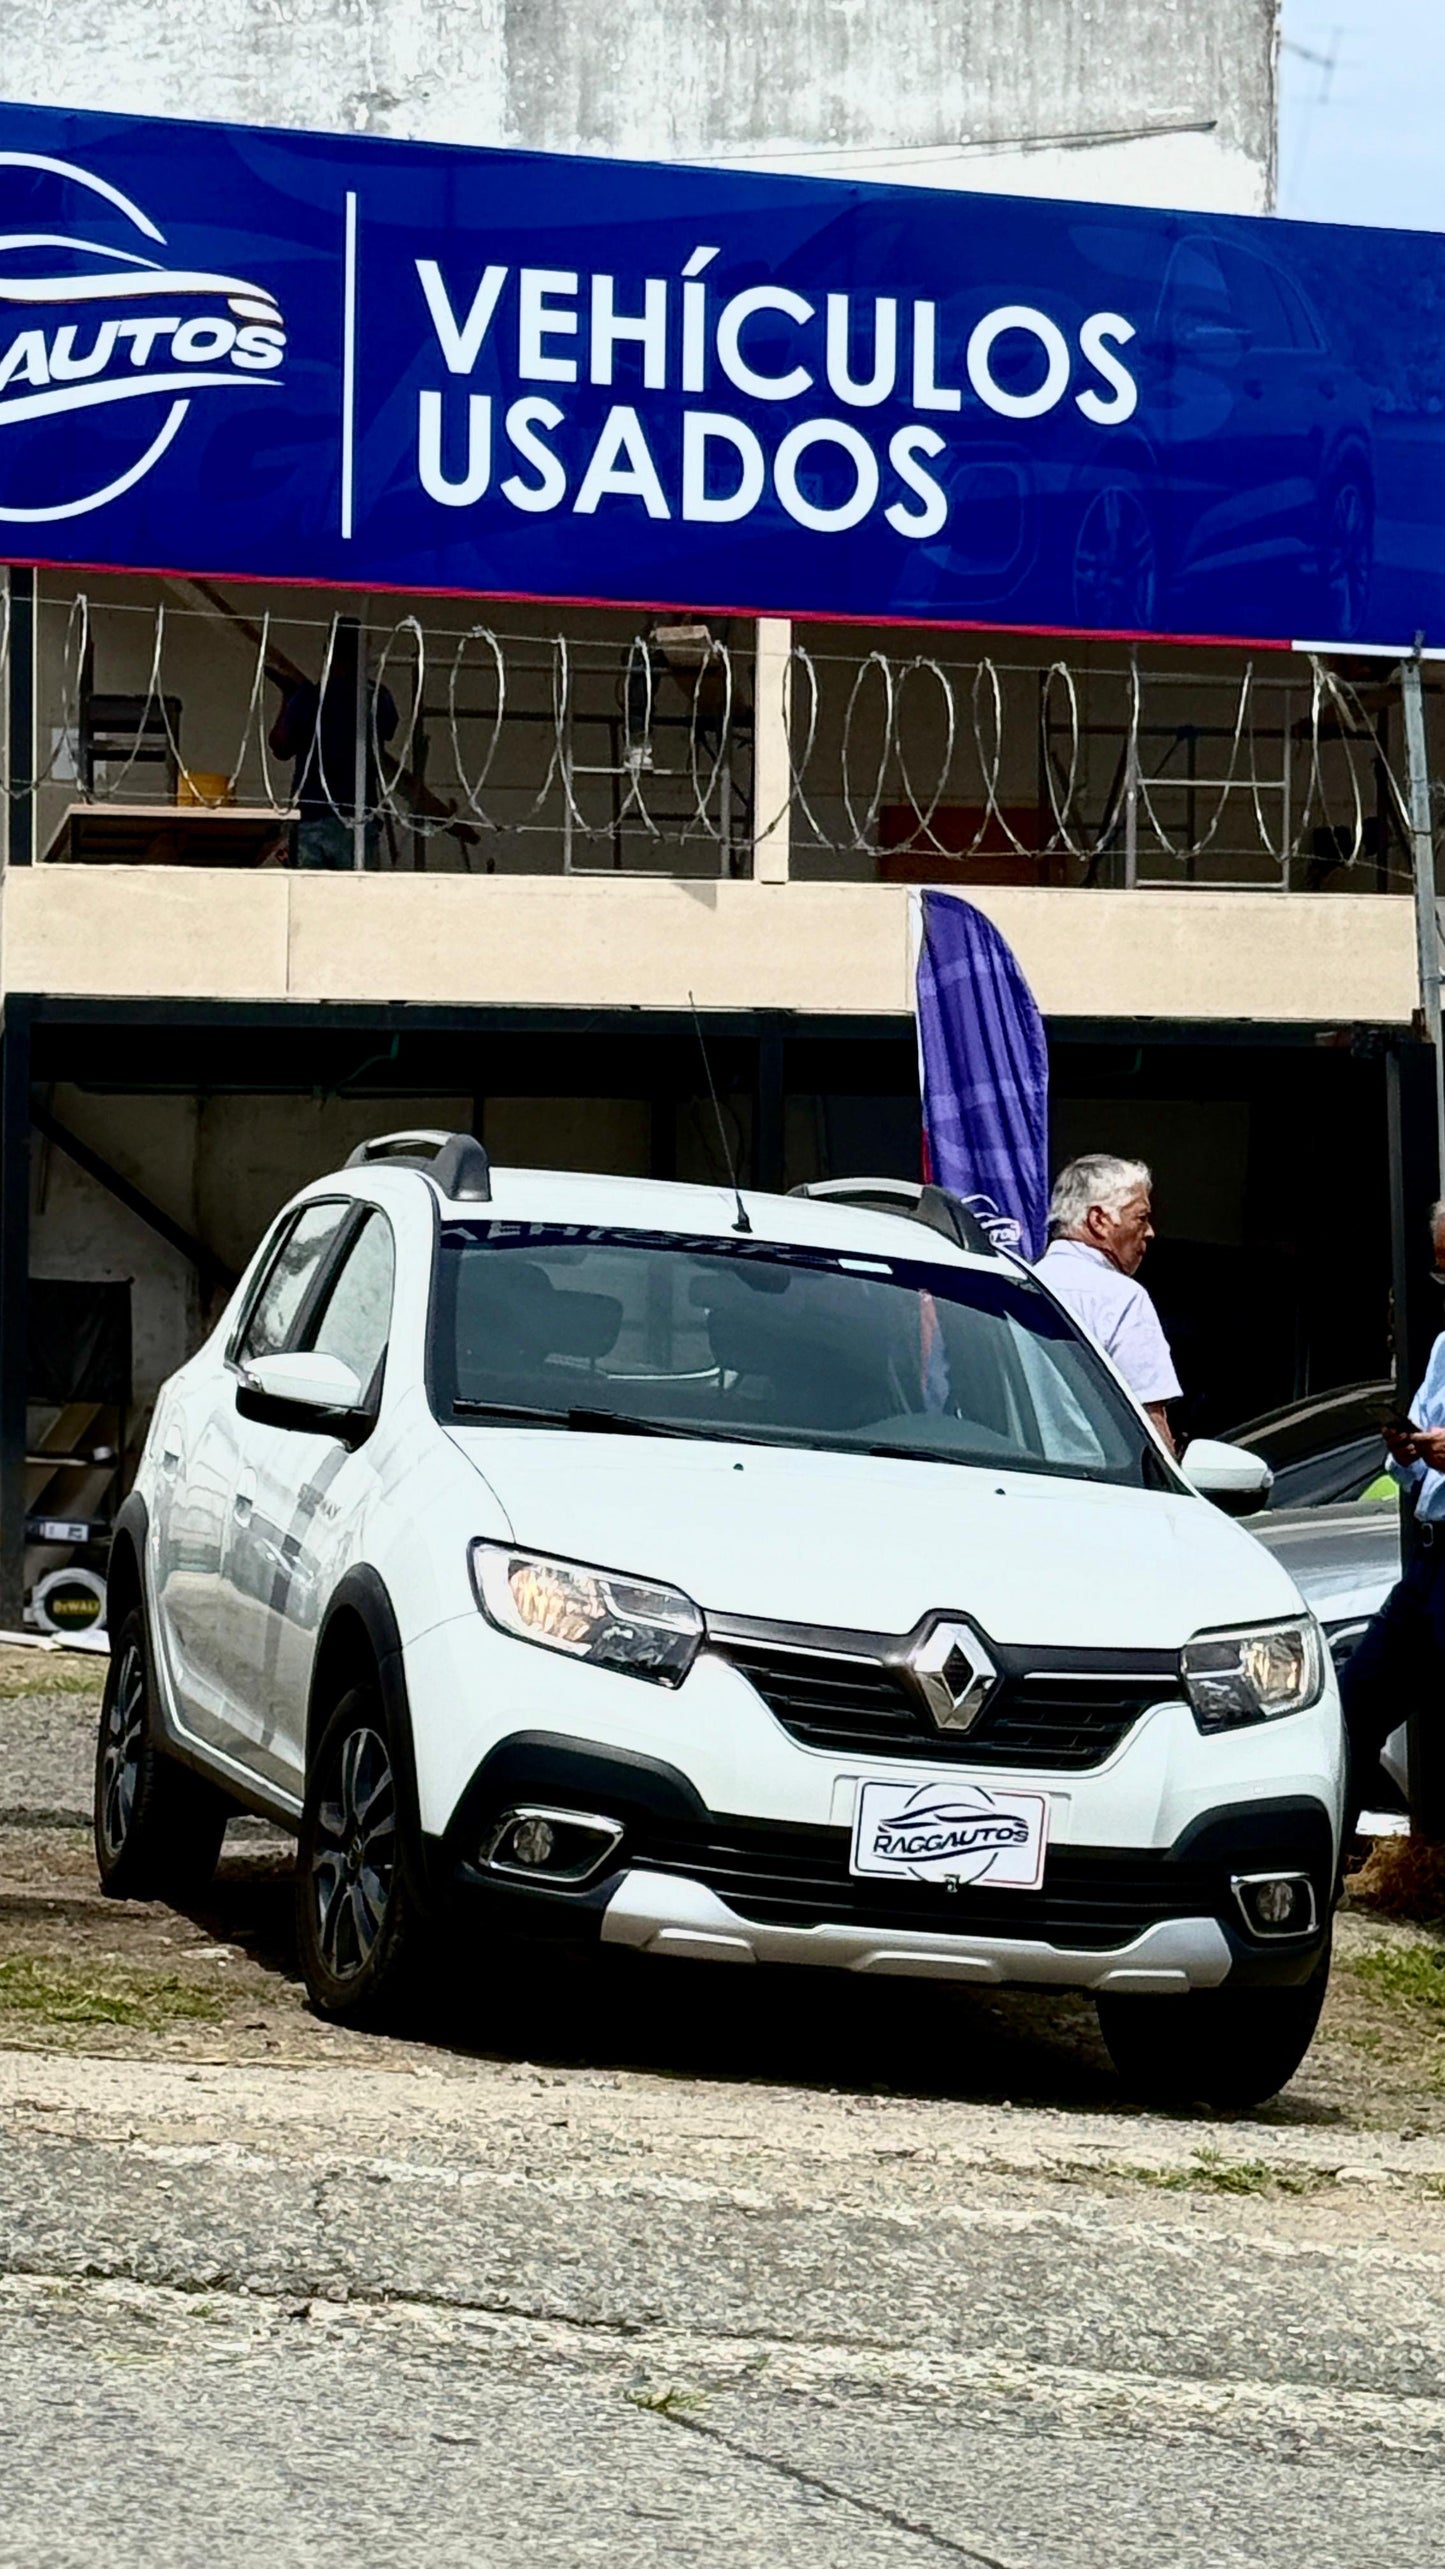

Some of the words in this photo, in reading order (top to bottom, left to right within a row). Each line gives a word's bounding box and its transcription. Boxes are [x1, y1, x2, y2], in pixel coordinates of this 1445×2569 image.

[416, 246, 1136, 425] VEHÍCULOS
[420, 391, 948, 538] USADOS
[873, 1827, 1029, 1854] RAGGAUTOS
